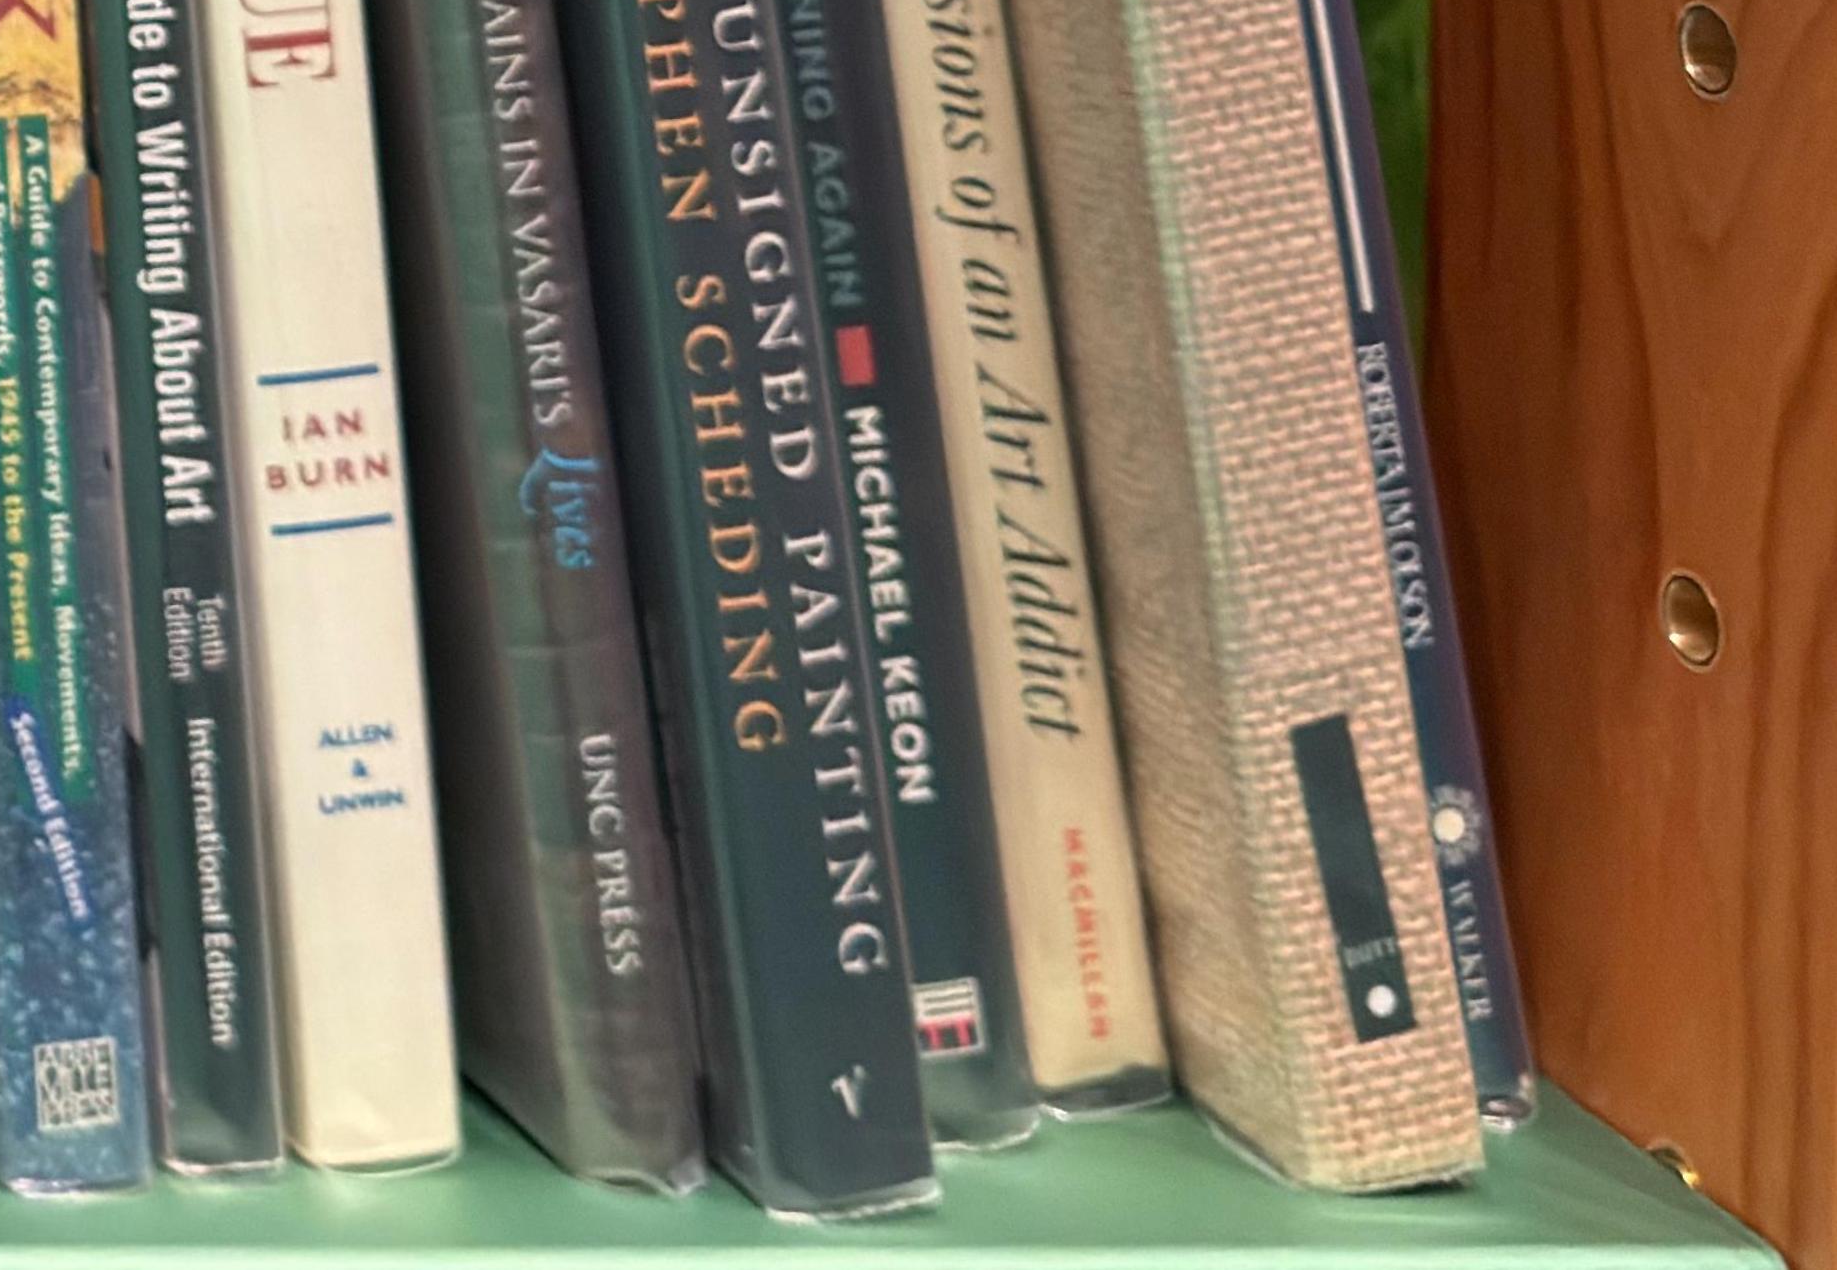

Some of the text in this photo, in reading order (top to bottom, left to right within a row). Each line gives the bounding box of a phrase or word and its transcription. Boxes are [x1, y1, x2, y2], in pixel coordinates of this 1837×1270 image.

[137, 122, 195, 293] Writing
[33, 297, 65, 504] Contemporary
[150, 309, 211, 441] About
[283, 409, 364, 441] IAN
[160, 456, 214, 523] Art
[266, 453, 391, 493] BURN
[673, 274, 788, 752] SCHEDING
[713, 3, 819, 479] UNSIGNED
[783, 530, 888, 974] PAINTING
[5, 553, 34, 660] Present
[163, 586, 197, 679] Edition
[196, 594, 226, 666] Tenth
[845, 405, 936, 802] MICHAEL KEON
[993, 507, 1088, 744] Addict
[1386, 540, 1435, 648] OLSON
[318, 722, 394, 749] ALLEN
[186, 718, 227, 924] International
[318, 789, 406, 815] UNWIN
[43, 816, 91, 920] Edition
[593, 848, 642, 975] PRESS
[1060, 828, 1111, 1040] MACMILLAN
[1448, 880, 1493, 1021] WALKER
